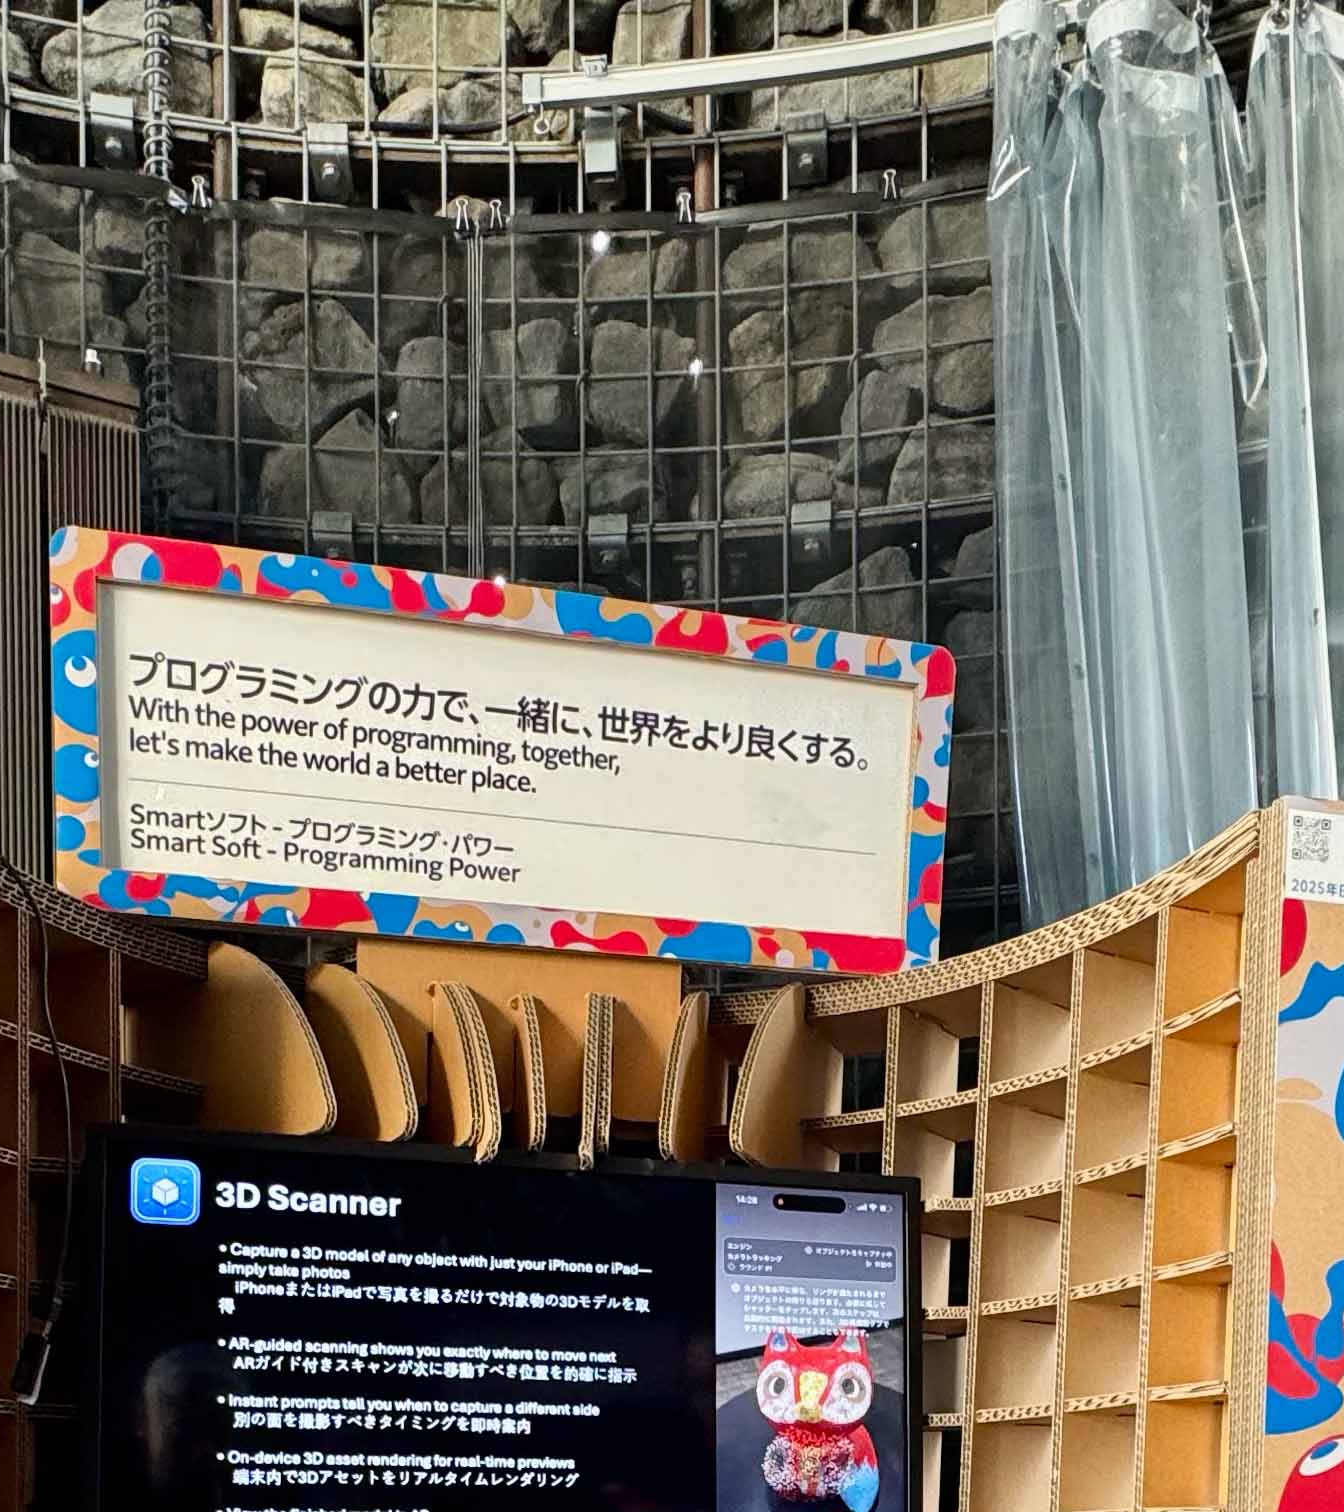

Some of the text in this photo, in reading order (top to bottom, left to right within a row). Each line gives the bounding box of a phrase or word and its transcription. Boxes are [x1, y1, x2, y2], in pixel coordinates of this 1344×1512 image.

[129, 652, 868, 770] プログラミングの力で、一緒に、世界をより良くする。
[129, 696, 620, 775] With the power of programming, together,
[130, 728, 537, 793] let's make the world a better place.
[130, 804, 268, 836] Smartソフト
[289, 819, 514, 856] プログラミング・パワー
[130, 828, 206, 854] Smart
[212, 835, 261, 858] Soft
[284, 842, 443, 878] Programming
[450, 857, 520, 882] Power
[216, 1181, 401, 1218] 3D Scanner
[218, 1262, 351, 1280] simply take photos
[230, 1243, 288, 1258] Capture
[290, 1247, 300, 1258] a
[302, 1246, 322, 1260] 3D
[325, 1248, 369, 1262] model
[372, 1250, 386, 1263] of
[388, 1253, 412, 1267] any
[415, 1252, 457, 1268] object
[459, 1255, 488, 1268] with
[490, 1256, 515, 1270] just
[516, 1259, 546, 1272] your
[548, 1259, 593, 1273] iPhone
[595, 1263, 609, 1274] or
[228, 1337, 617, 1364] AR-guided scanning shows you exactly where to move next
[228, 1394, 600, 1417] Instant prompts tell you when to capture a different side
[227, 1450, 575, 1470] On-device 3D asset rendering for real-time previews
